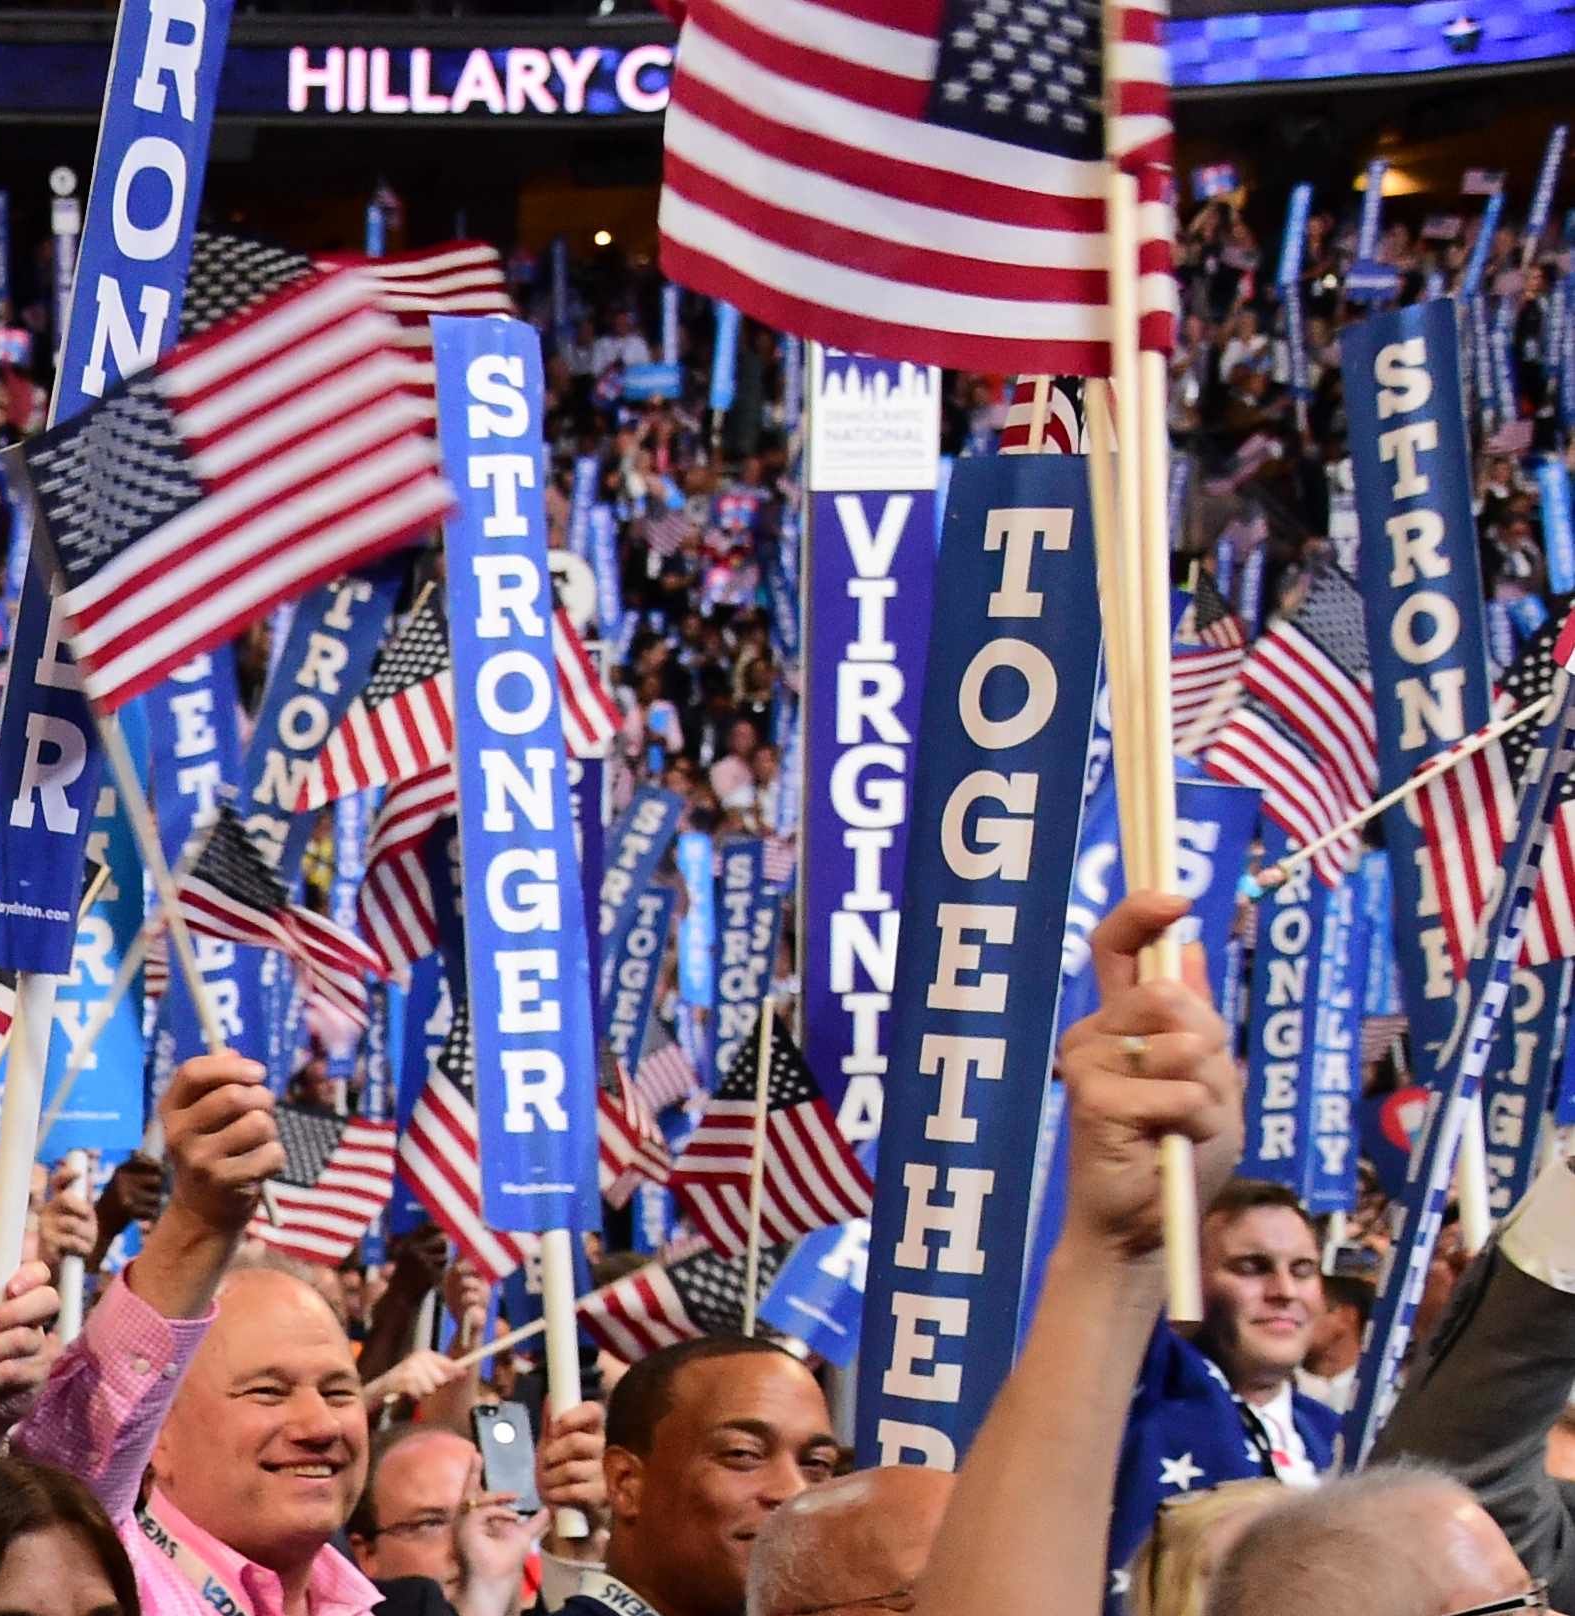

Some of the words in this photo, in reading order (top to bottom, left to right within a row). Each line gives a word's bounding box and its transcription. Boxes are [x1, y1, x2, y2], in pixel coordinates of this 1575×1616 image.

[289, 46, 600, 115] HILLARY
[464, 354, 569, 1133] STRONGER
[828, 496, 912, 1143] VIRGINIA
